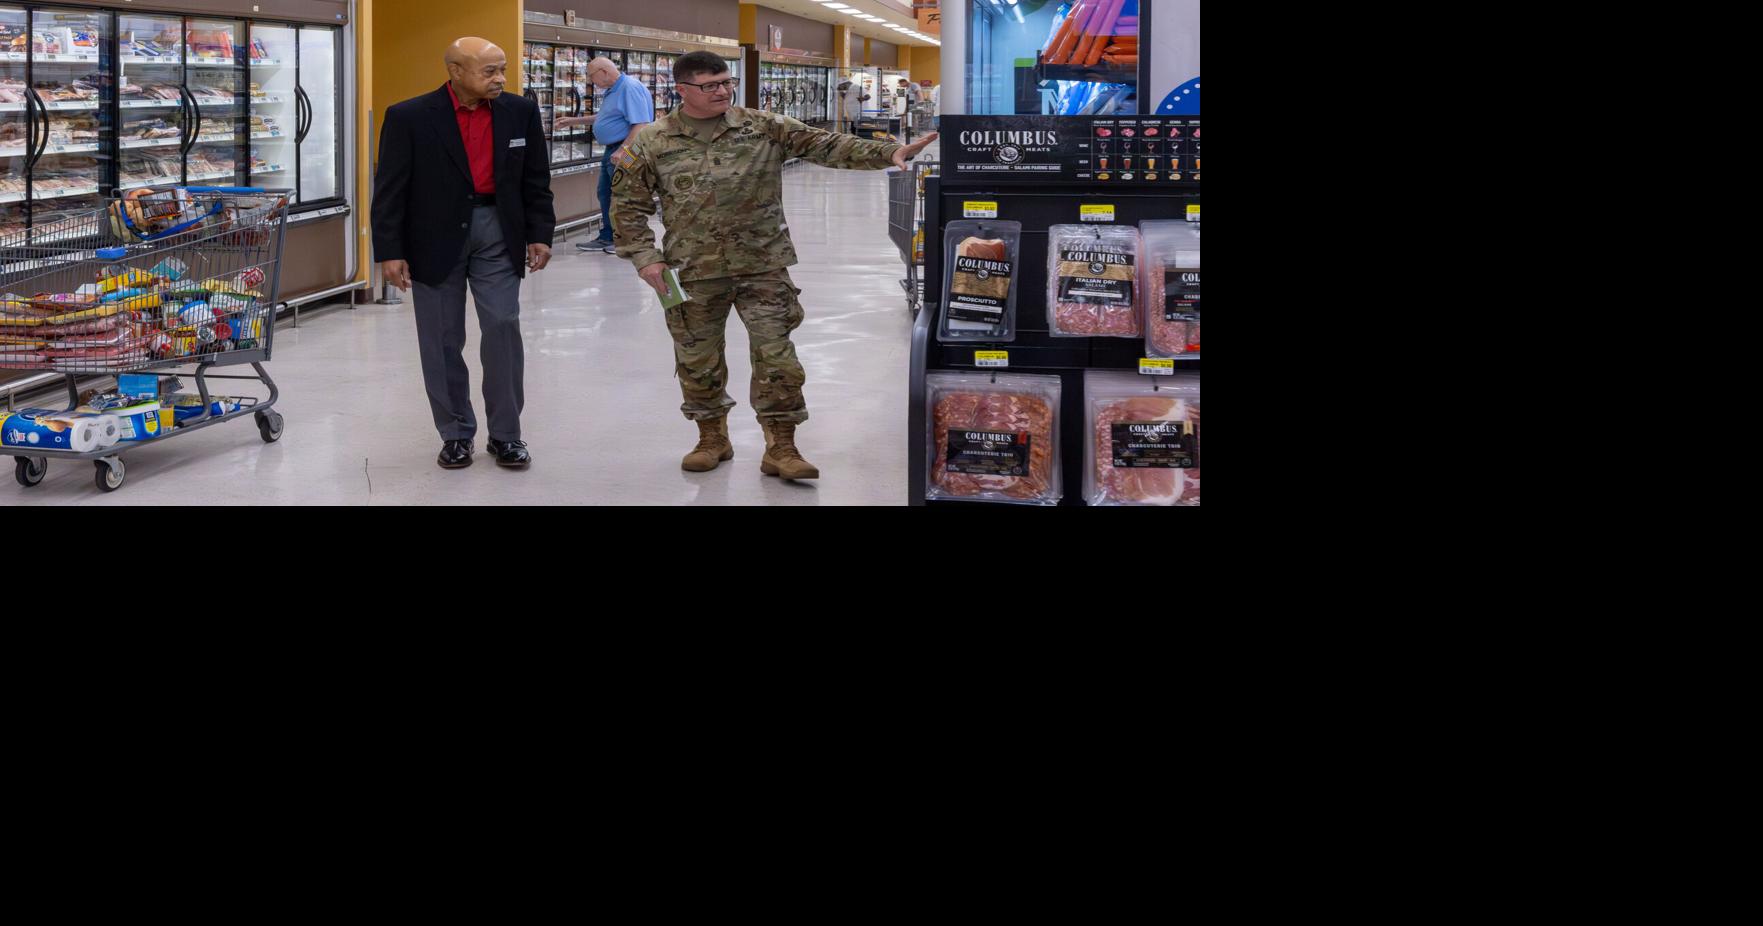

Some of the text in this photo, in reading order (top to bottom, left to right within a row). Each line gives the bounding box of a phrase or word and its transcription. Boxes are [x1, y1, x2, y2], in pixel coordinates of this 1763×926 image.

[960, 131, 1057, 145] COLUMBUS
[1068, 251, 1127, 264] COLUMBUS
[959, 258, 1010, 272] COLUMBUS
[957, 296, 997, 305] PROSCIUTTO
[1129, 424, 1178, 433] COLUMBUS
[965, 432, 1012, 442] COLUMBUS
